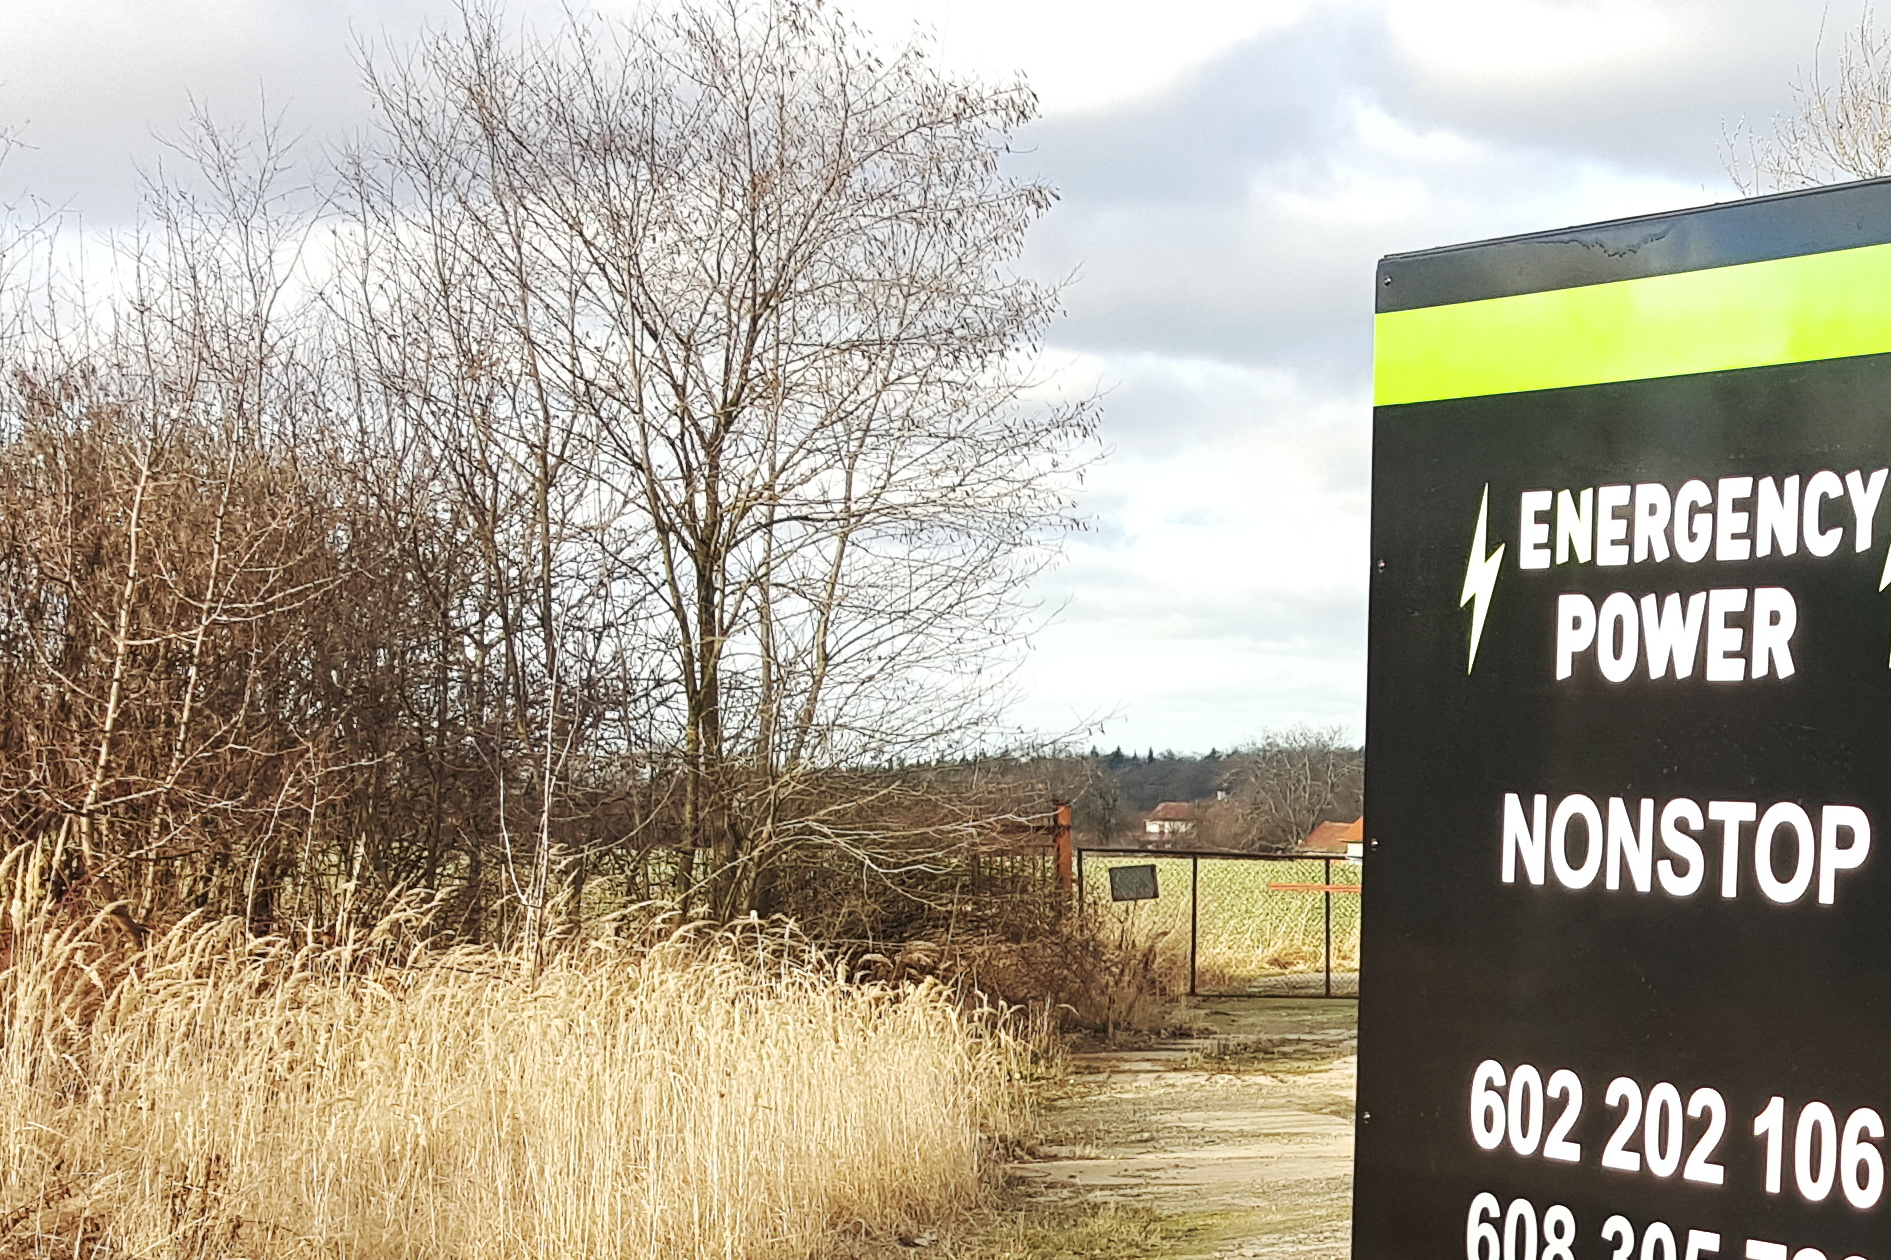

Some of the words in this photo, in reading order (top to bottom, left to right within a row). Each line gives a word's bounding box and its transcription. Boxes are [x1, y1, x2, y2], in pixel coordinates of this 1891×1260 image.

[1519, 467, 1889, 570] ENERGENCY
[1555, 586, 1798, 683] POWER
[1501, 792, 1871, 905] NONSTOP
[1470, 1059, 1583, 1163] 602
[1601, 1076, 1727, 1185] 202
[1753, 1096, 1885, 1210] 106
